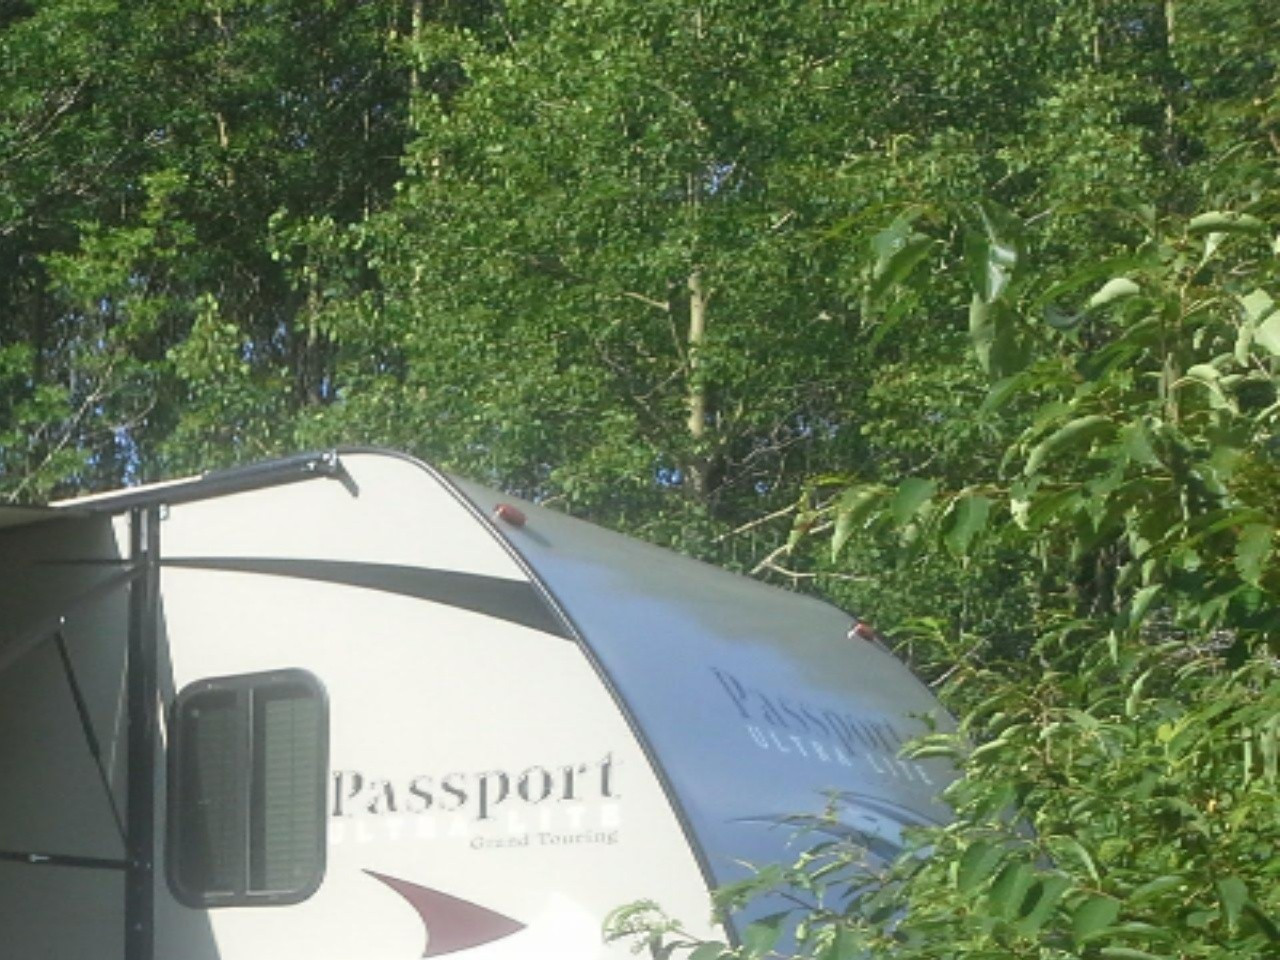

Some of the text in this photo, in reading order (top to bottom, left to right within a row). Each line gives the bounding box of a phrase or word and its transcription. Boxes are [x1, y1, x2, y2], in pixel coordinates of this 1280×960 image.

[747, 725, 851, 768] ULTRA
[331, 750, 624, 822] Passport
[507, 802, 621, 833] LITE
[469, 829, 620, 850] Grand Touring
